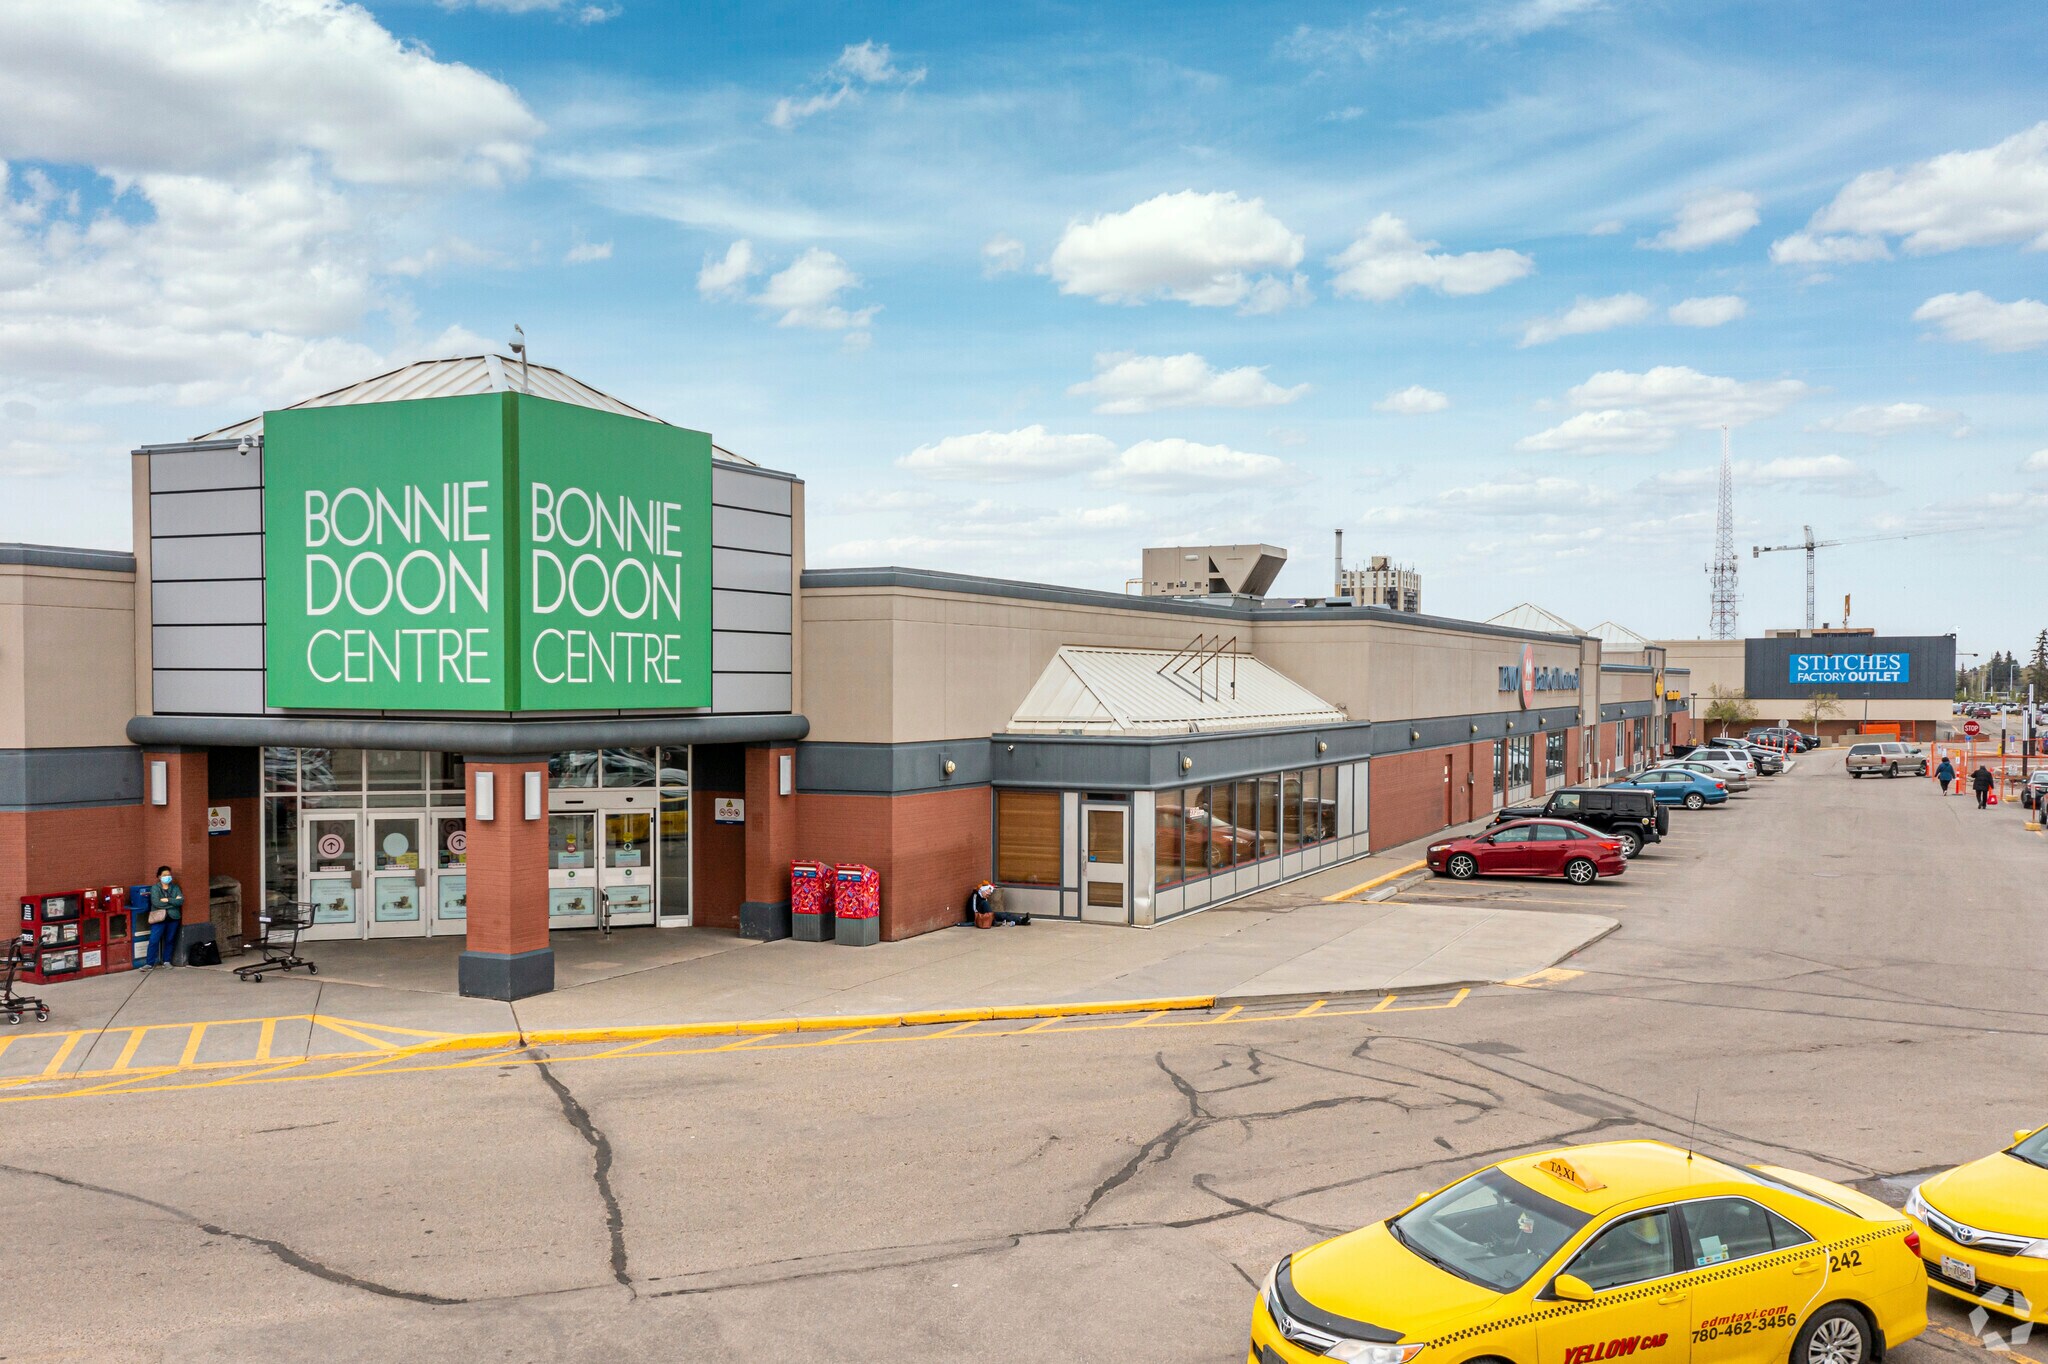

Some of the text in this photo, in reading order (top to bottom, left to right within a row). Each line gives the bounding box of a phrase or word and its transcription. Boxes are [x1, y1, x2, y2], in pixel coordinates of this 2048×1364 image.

[305, 481, 490, 547] BONNIE
[532, 482, 683, 557] BONNIE
[306, 548, 489, 616] DOON
[532, 549, 681, 621] DOON
[307, 628, 491, 683] CENTRE
[532, 628, 682, 684] CENTRE
[1797, 654, 1901, 671] STITCHES
[1797, 671, 1900, 682] FACTORY OUTLET
[1550, 1161, 1575, 1181] TAXI
[1829, 1250, 1862, 1273] 242
[1692, 1313, 1797, 1344] 780-462-3456
[1701, 1305, 1789, 1329] edmtaxi.com
[1563, 1332, 1669, 1364] YELLOW CAB
